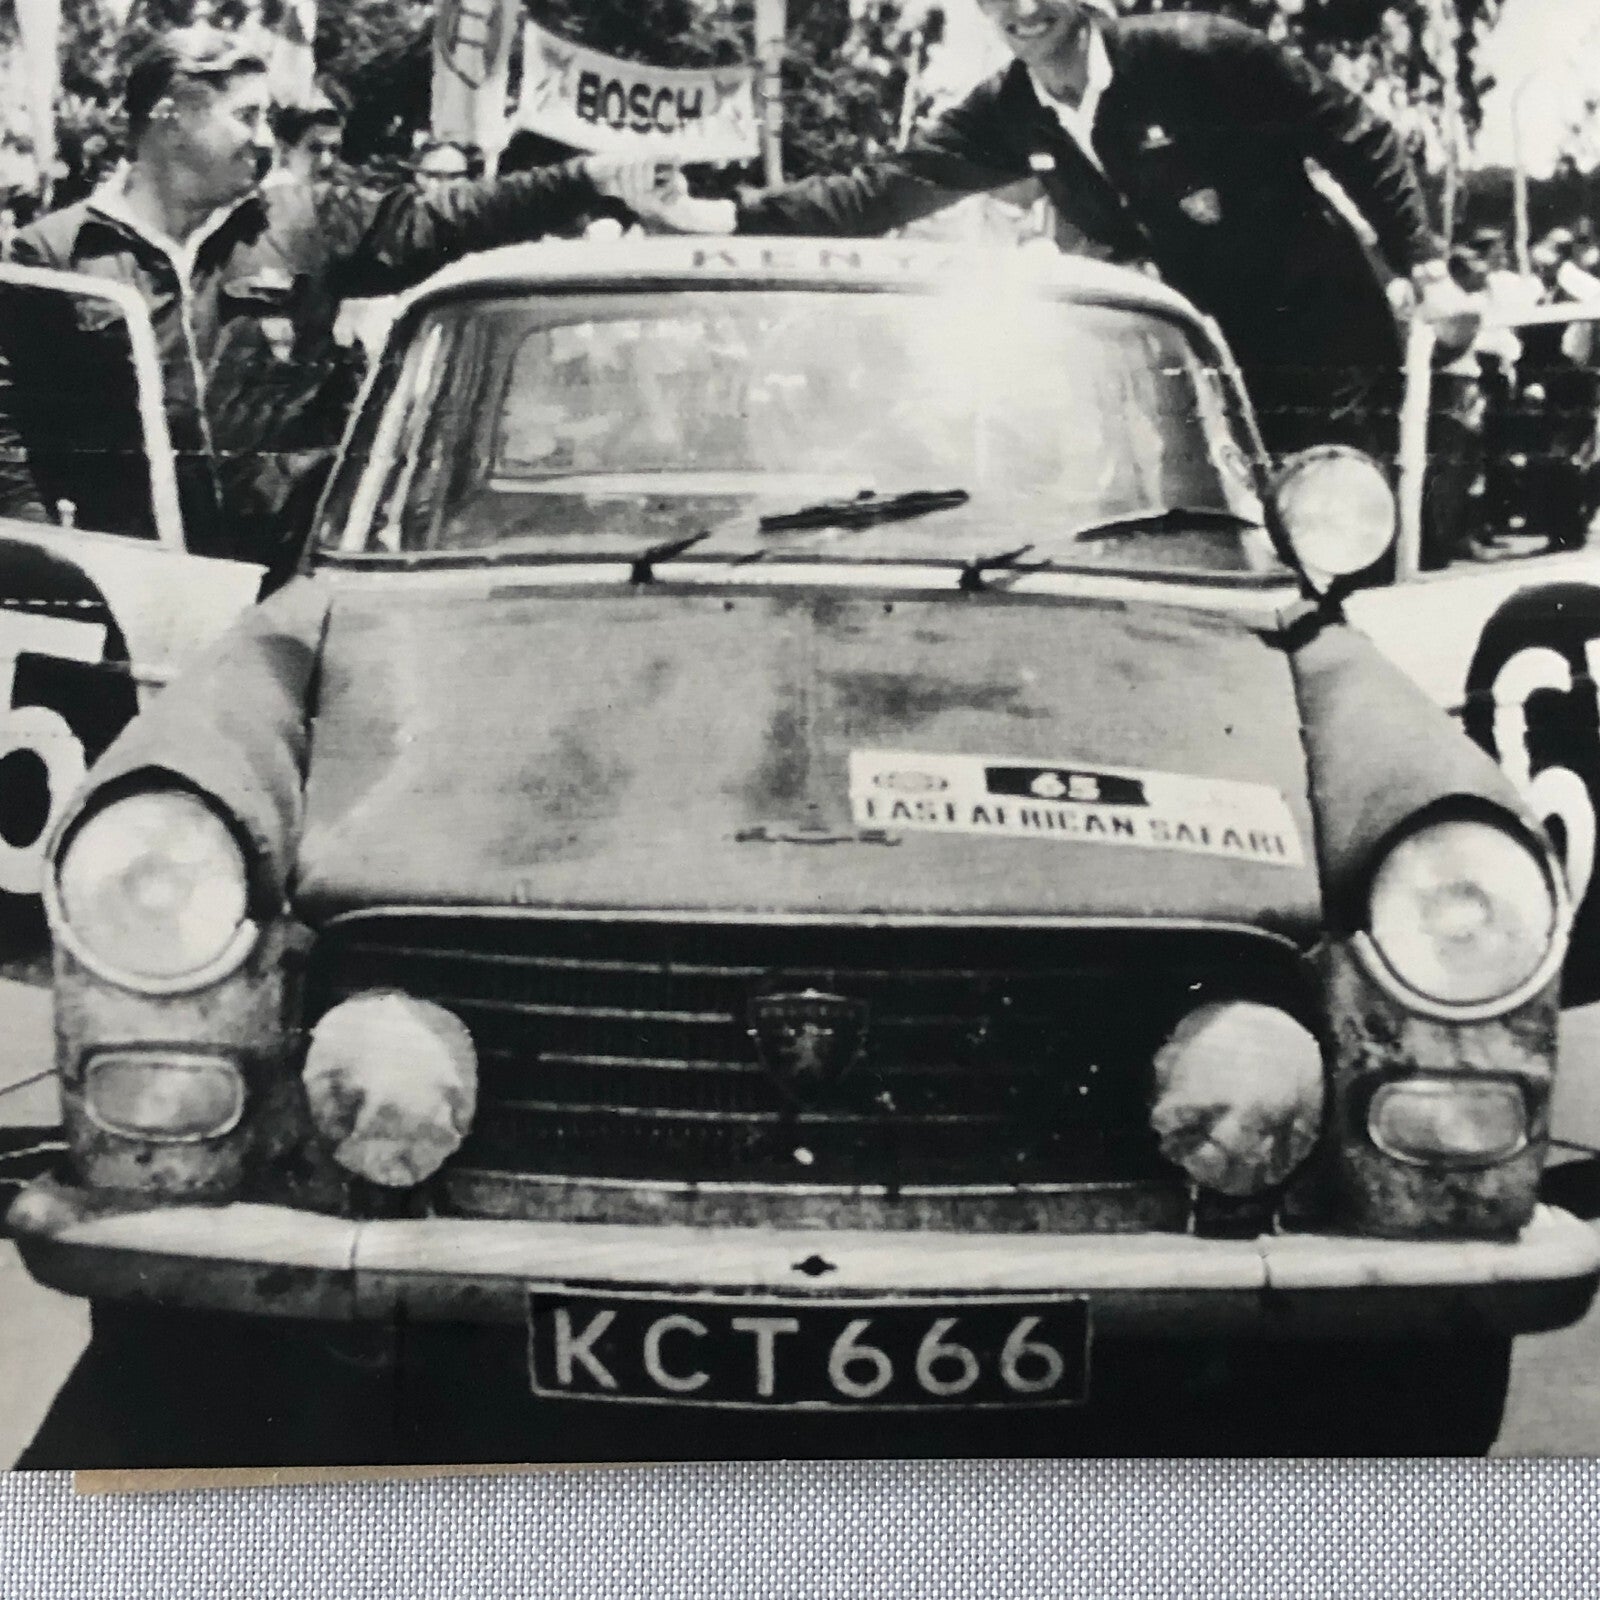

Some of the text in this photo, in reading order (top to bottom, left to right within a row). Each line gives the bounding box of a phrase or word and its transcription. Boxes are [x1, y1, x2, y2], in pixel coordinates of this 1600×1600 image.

[576, 71, 703, 133] BOSCH
[692, 249, 962, 270] KENY
[1031, 771, 1100, 801] 65
[553, 1308, 1065, 1399] KCT666
